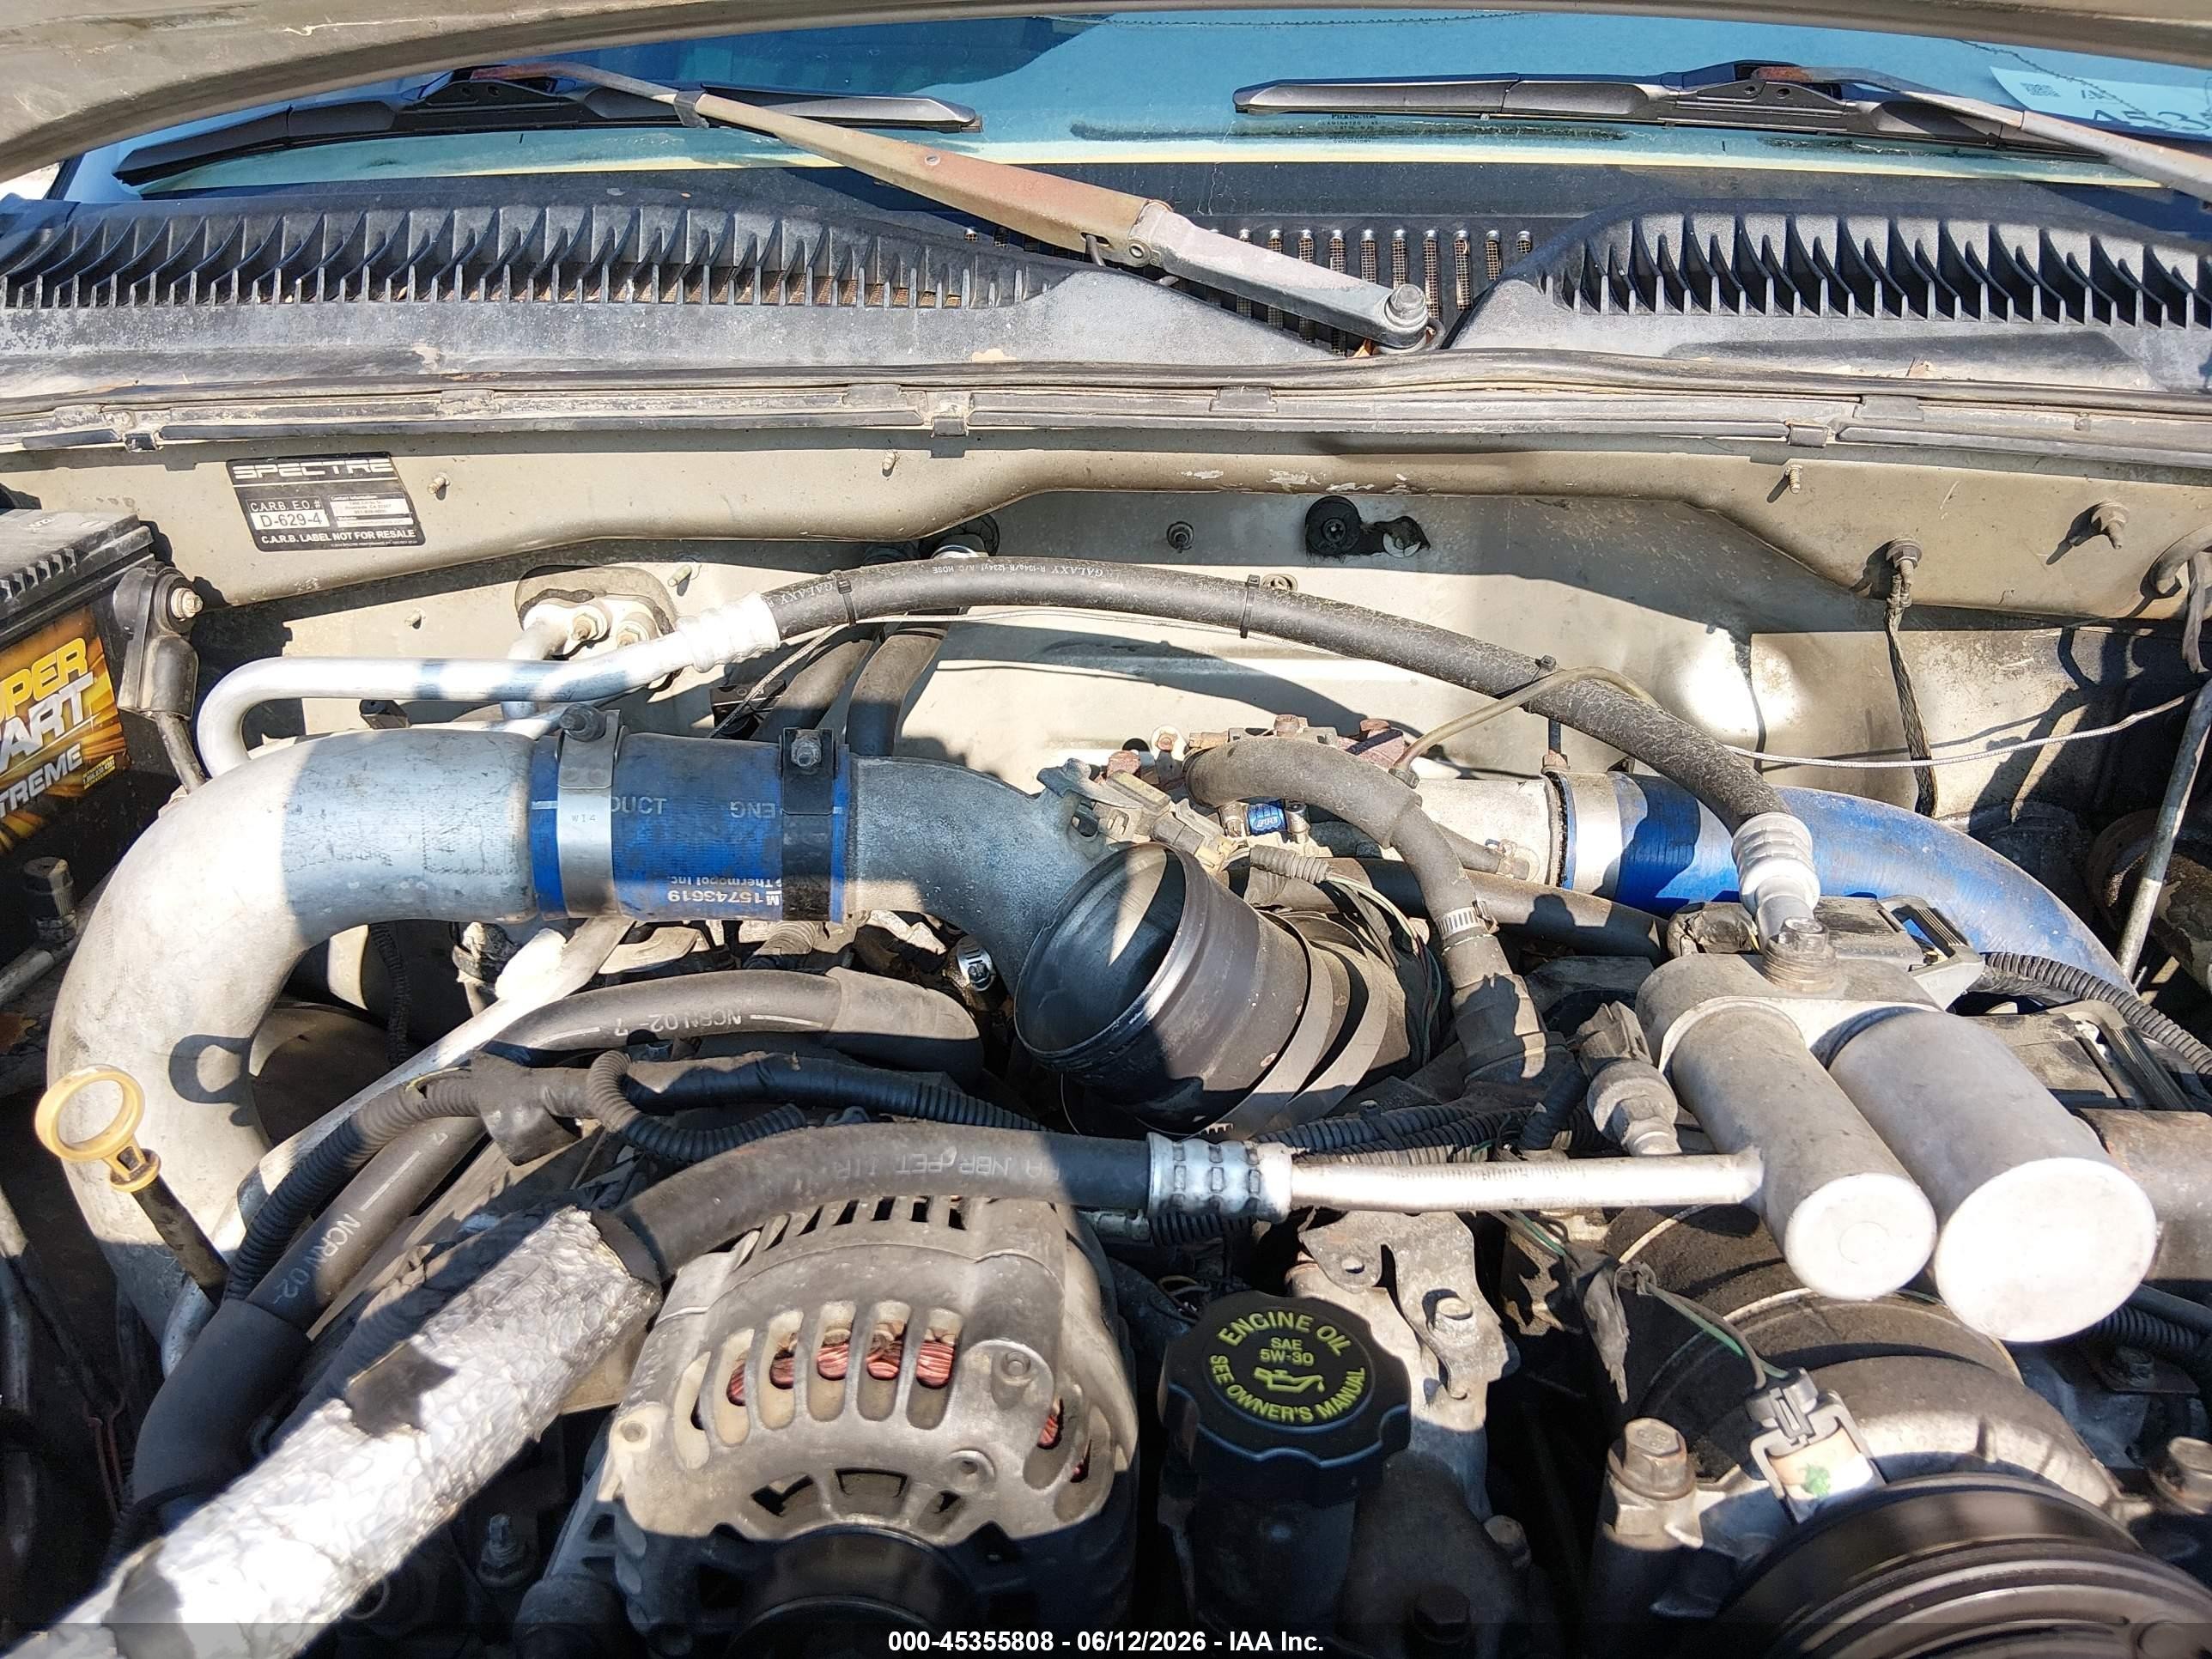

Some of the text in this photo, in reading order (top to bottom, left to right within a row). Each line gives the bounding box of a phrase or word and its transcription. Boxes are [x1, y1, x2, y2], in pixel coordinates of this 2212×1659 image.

[233, 459, 394, 479] SPECTRE
[250, 501, 289, 512] C.A.R.B.
[259, 512, 322, 527] D-629-4
[261, 528, 416, 544] C.A.R.B. LABEL NOT FOR RESALE
[931, 564, 954, 574] HOSE
[1051, 564, 1104, 578] GALAXY
[779, 581, 833, 605] GALAXY
[731, 800, 776, 818] ENG
[667, 876, 691, 886] Inc.
[696, 876, 772, 888] Thermopol
[667, 890, 764, 903] 15743619
[958, 1154, 1012, 1176] NBR
[1218, 1311, 1352, 1356] ENGINE OIL
[1270, 1337, 1304, 1352] SAE
[1259, 1348, 1315, 1367] 5W-30
[1209, 1353, 1366, 1423] SEE OWNER'S MANUAL
